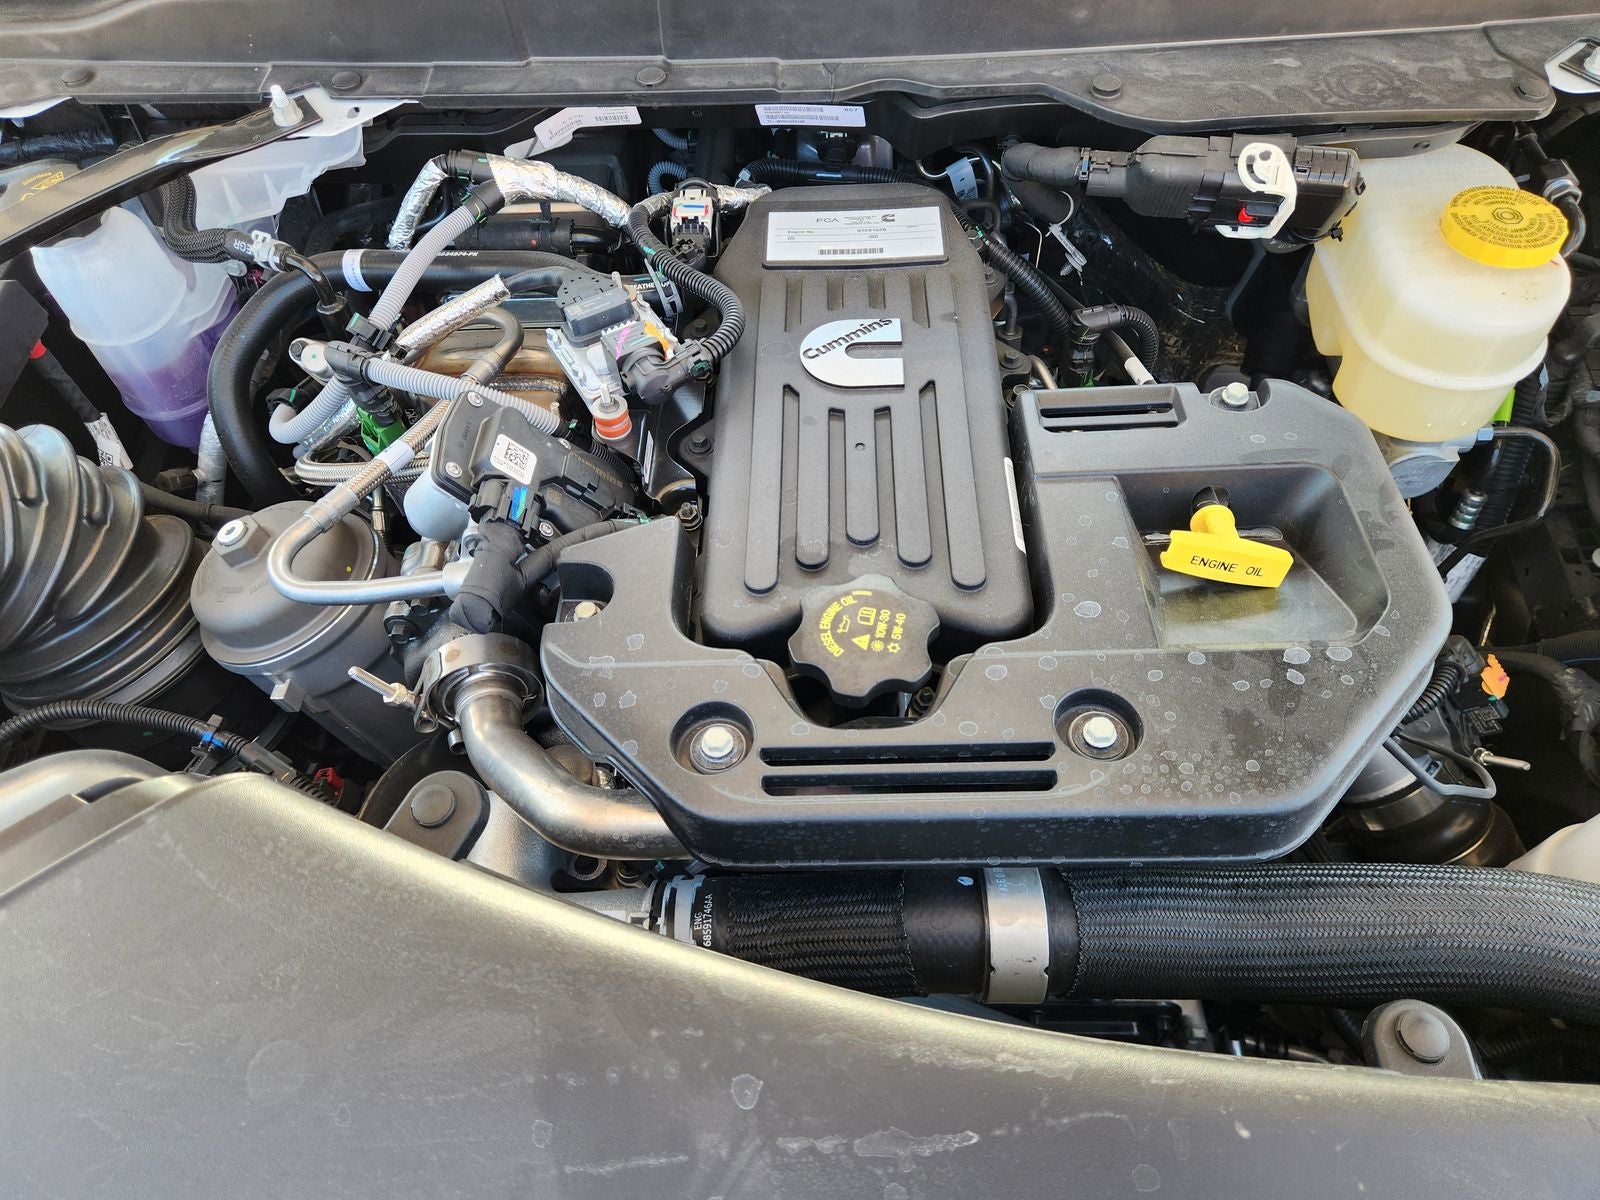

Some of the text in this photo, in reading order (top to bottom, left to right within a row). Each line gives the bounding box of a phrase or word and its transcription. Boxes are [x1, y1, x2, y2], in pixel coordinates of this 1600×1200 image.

[233, 238, 252, 255] EGR
[802, 318, 893, 360] Cummins
[1190, 555, 1264, 577] ENGINE OIL
[819, 595, 858, 658] DIESEL ENGINE OIL
[875, 609, 891, 638] 10W-30
[891, 612, 906, 640] 5W-40
[693, 911, 703, 931] ENG
[702, 893, 713, 947] 68591746AA
